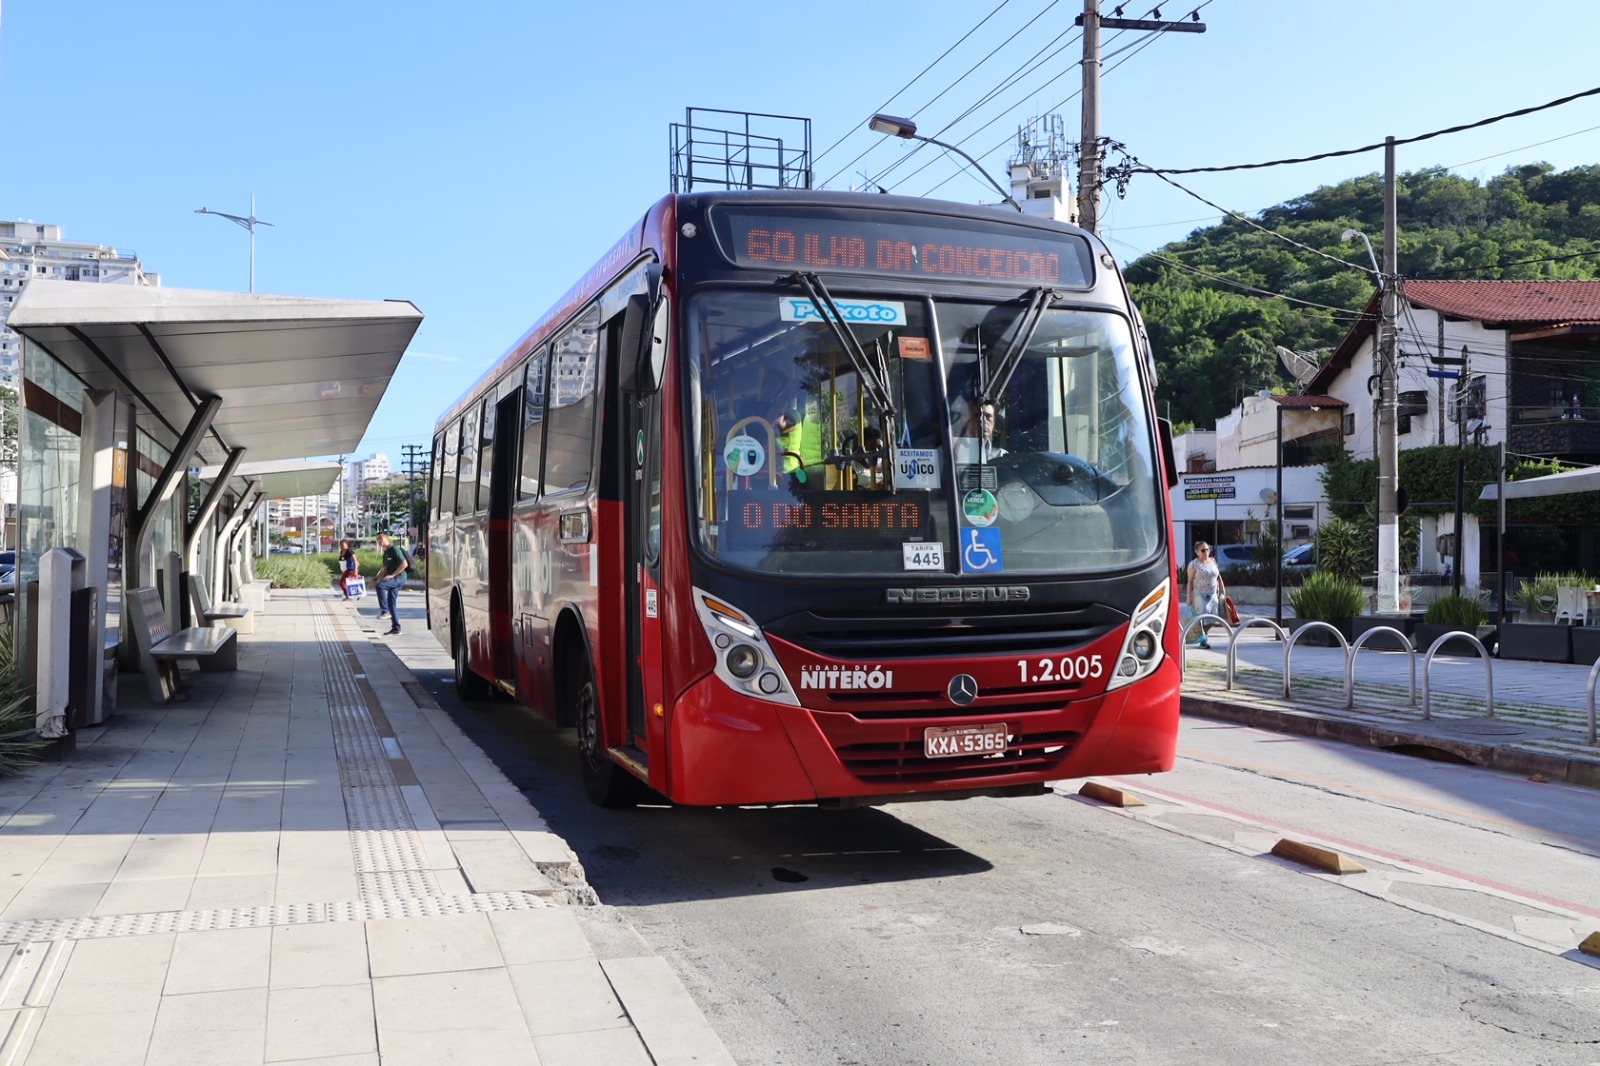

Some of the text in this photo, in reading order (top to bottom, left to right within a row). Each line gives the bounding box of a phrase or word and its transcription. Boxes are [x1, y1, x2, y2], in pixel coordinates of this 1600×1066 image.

[804, 233, 866, 268] ILHA
[876, 239, 912, 271] DA
[922, 243, 1059, 282] CONCEICAO
[900, 450, 933, 458] ACEITAMOS
[901, 459, 934, 475] ÚNICO
[773, 502, 812, 528] DO
[822, 502, 919, 528] SANTA
[886, 585, 1031, 603] NEOBUS
[800, 664, 893, 689] NITERÓI
[1017, 654, 1103, 683] 1.2.005
